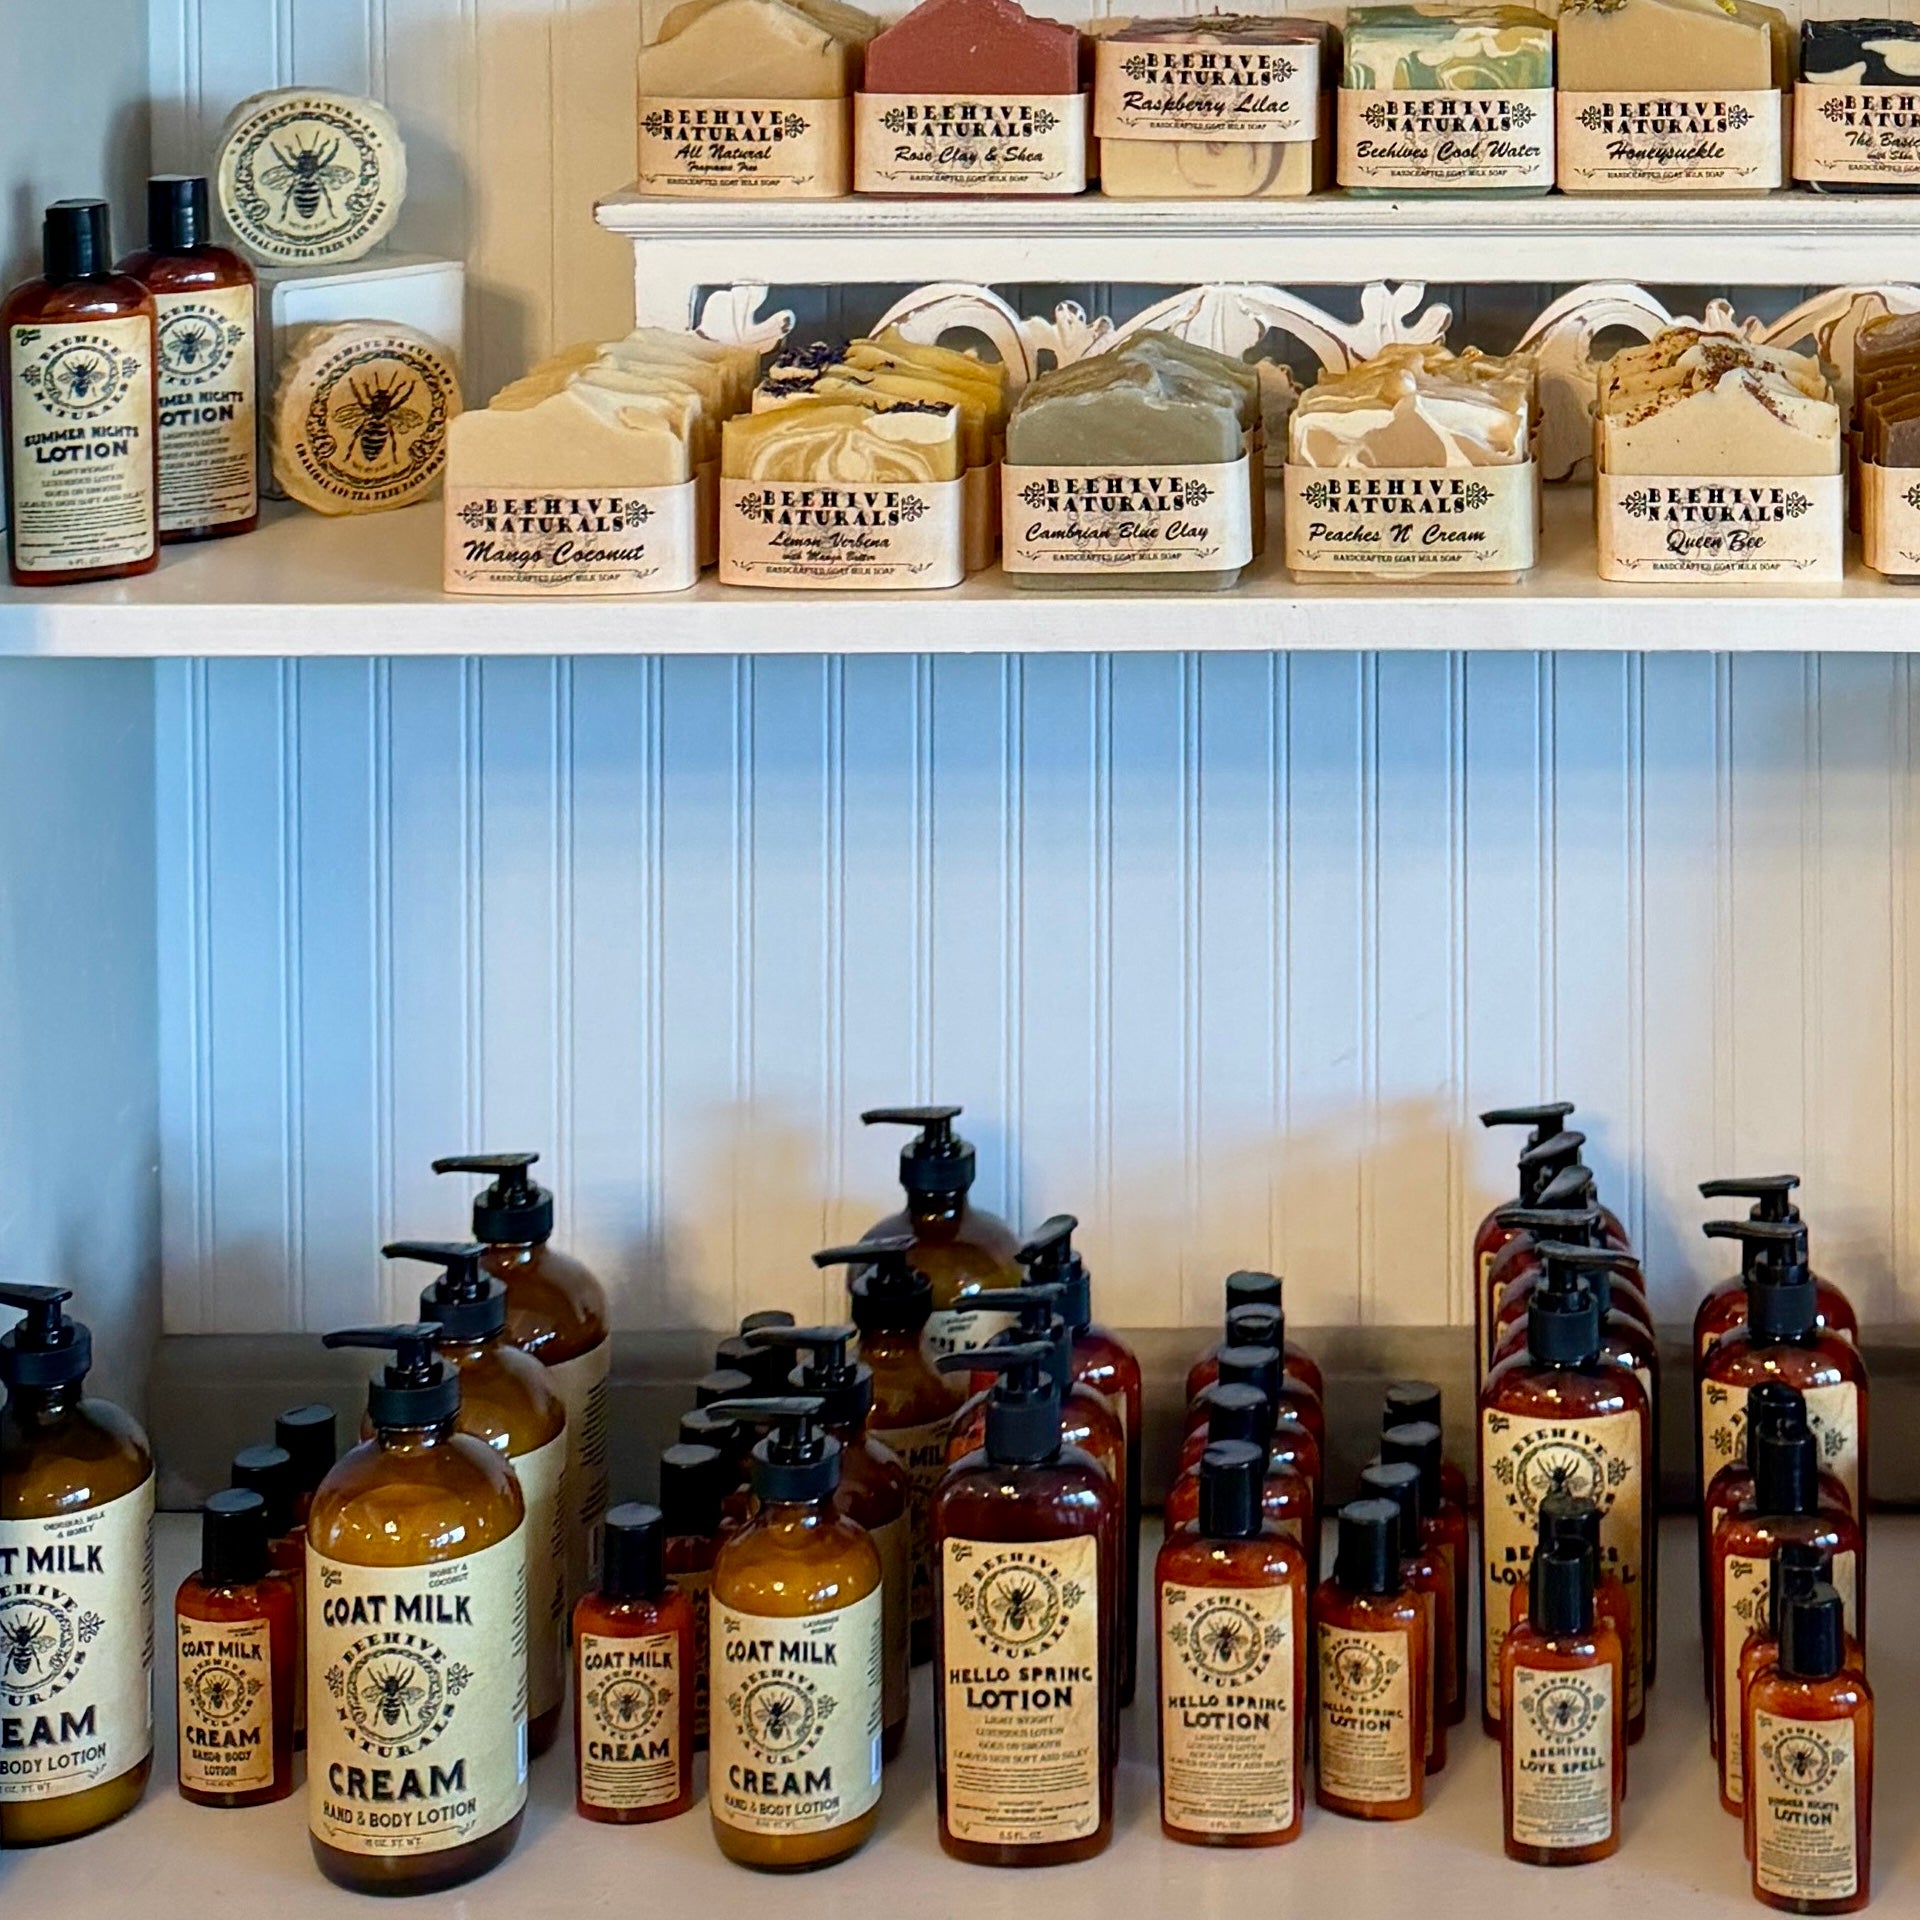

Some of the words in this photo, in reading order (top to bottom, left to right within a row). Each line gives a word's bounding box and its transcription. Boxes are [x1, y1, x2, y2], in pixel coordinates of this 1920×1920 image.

[1146, 52, 1271, 69] BEEHIVE
[1146, 70, 1272, 86] NATURALS
[906, 106, 1032, 120] BEEHIVE
[1122, 92, 1226, 114] Raspberry
[1232, 93, 1289, 113] Lilac
[1386, 100, 1511, 116] BEEHIVE
[1602, 102, 1726, 117] BEEHIVE
[662, 110, 783, 124] BEEHIVE
[1386, 116, 1511, 132] NATURALS
[1602, 119, 1727, 133] NATURALS
[662, 126, 784, 141] NATURALS
[906, 122, 1032, 137] NATURALS
[1845, 131, 1873, 146] The
[675, 144, 706, 160] All
[710, 144, 772, 161] Natural
[895, 146, 932, 162] Rose
[938, 146, 976, 167] Clay
[985, 146, 996, 162] &
[1003, 146, 1044, 162] Shea
[1357, 142, 1428, 158] Beehives
[1437, 142, 1478, 162] Cool
[1488, 142, 1540, 158] Water
[1606, 142, 1725, 164] Honeysuckle
[40, 335, 119, 361] BEEHIVE
[34, 383, 129, 420] NATURALS
[160, 404, 234, 426] OTION
[25, 428, 86, 447] SUMMER
[91, 426, 139, 439] NIGHTS
[36, 440, 128, 464] LOTION
[1046, 477, 1183, 494] BEEHIVE
[1328, 480, 1464, 496] BEEHIVE
[485, 498, 623, 514] BEEHIVE
[763, 490, 899, 507] BEEHIVE
[1046, 495, 1184, 512] NATURALS
[1328, 497, 1464, 514] NATURALS
[1648, 488, 1784, 504] BEEHIVE
[762, 509, 900, 526] NATURALS
[1648, 506, 1784, 522] NATURALS
[485, 517, 624, 532] NATURALS
[1025, 522, 1111, 542] Cambrian
[1118, 522, 1159, 538] Blue
[1166, 520, 1208, 540] Clay
[1308, 522, 1381, 542] Peaches
[1422, 524, 1486, 545] Cream
[768, 531, 822, 548] Lemon
[830, 532, 890, 548] Verbena
[1666, 530, 1723, 555] Queen
[1728, 530, 1766, 551] Bee
[463, 540, 542, 568] Mango
[552, 540, 644, 566] Coconut
[1512, 1428, 1607, 1456] BEEHIVE
[27, 1545, 104, 1574] MILK
[973, 1552, 1061, 1581] BEEHIVE
[394, 1594, 474, 1626] MILK
[1185, 1596, 1264, 1620] BEEHIVE
[970, 1614, 1070, 1658] NATURALS
[218, 1640, 262, 1661] MILK
[342, 1632, 446, 1664] BEEHIVE
[780, 1640, 838, 1666] MILK
[629, 1652, 672, 1670] MILK
[1182, 1652, 1271, 1688] NATURALS
[740, 1669, 818, 1694] BEEHIVE
[950, 1668, 1010, 1684] HELLO
[1019, 1666, 1093, 1682] SPRING
[967, 1687, 1072, 1710] LOTION
[1168, 1696, 1218, 1708] HELLO
[1226, 1696, 1288, 1712] SPRING
[1323, 1702, 1354, 1718] HELLO
[336, 1703, 456, 1758] NATURALS
[1183, 1711, 1270, 1731] LOTION
[1330, 1715, 1391, 1731] LOTION
[186, 1726, 261, 1748] CREAM
[736, 1724, 824, 1766] NATURALS
[0, 1758, 42, 1774] BODY
[48, 1743, 106, 1771] LOTION
[588, 1738, 670, 1762] CREAM
[204, 1764, 237, 1776] LOTION
[1520, 1760, 1555, 1773] LOVE
[1562, 1760, 1605, 1774] SPELL
[328, 1758, 466, 1800] CREAM
[728, 1764, 832, 1796] CREAM
[323, 1801, 352, 1824] HAND
[356, 1809, 364, 1826] &
[370, 1811, 412, 1828] BODY
[418, 1798, 477, 1826] LOTION
[724, 1793, 748, 1810] HAND
[759, 1802, 790, 1815] BODY
[795, 1797, 840, 1814] LOTION
[1774, 1808, 1832, 1826] LOTION
